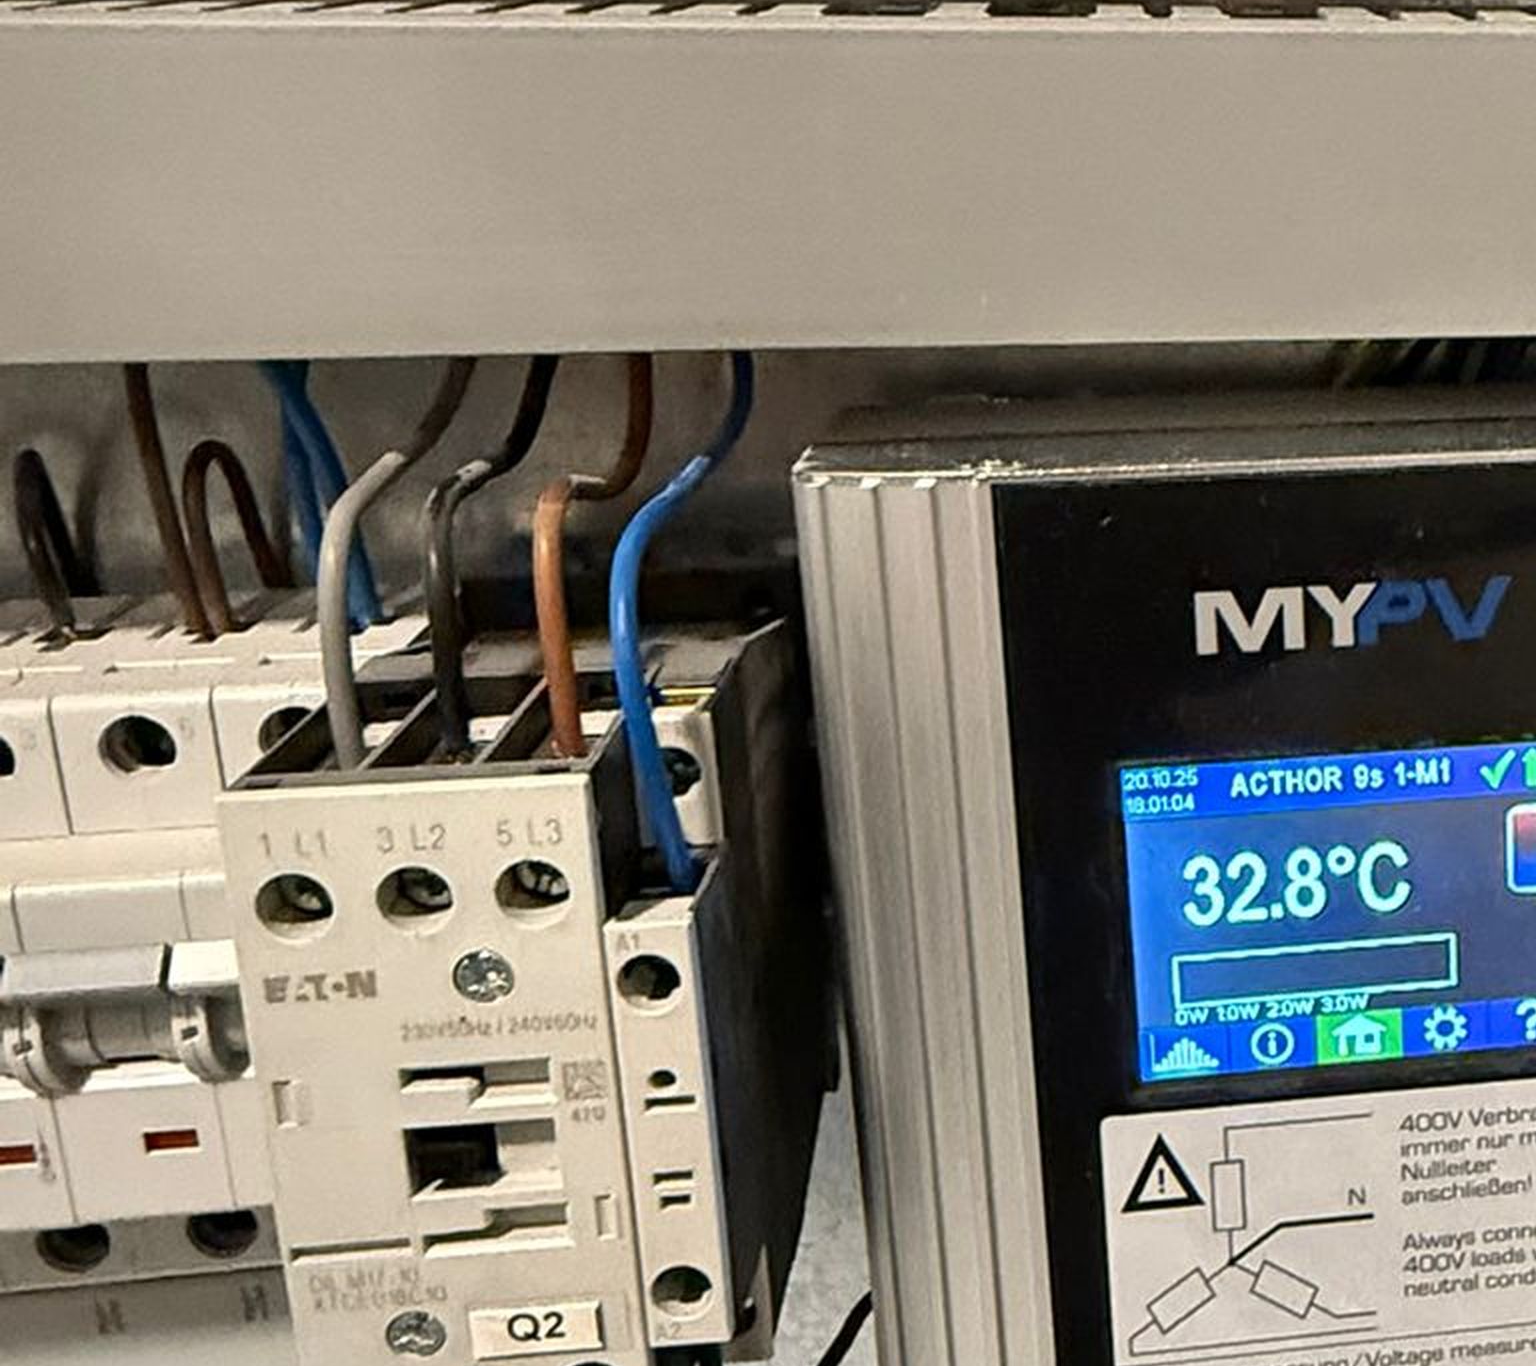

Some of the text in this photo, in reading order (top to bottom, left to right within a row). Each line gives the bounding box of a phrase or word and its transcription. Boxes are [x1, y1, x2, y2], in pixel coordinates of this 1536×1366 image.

[1230, 765, 1344, 798] ACTHOR
[1353, 763, 1384, 790] 9s
[377, 825, 395, 853] 3
[411, 823, 447, 851] L2
[497, 820, 514, 846] 5
[527, 818, 564, 846] L3
[1182, 840, 1413, 927] 32.8°C
[1319, 992, 1371, 1015] 3.0W
[1400, 1110, 1464, 1133] 400V
[1400, 1137, 1472, 1158] immer
[1476, 1132, 1514, 1150] nur
[1347, 1186, 1368, 1207] N
[1401, 1173, 1534, 1206] anschließen!
[1402, 1231, 1477, 1253] Always
[1403, 1252, 1467, 1274] 400V
[1471, 1247, 1527, 1269] loads
[1404, 1272, 1480, 1298] neutral
[506, 1310, 567, 1343] Q2
